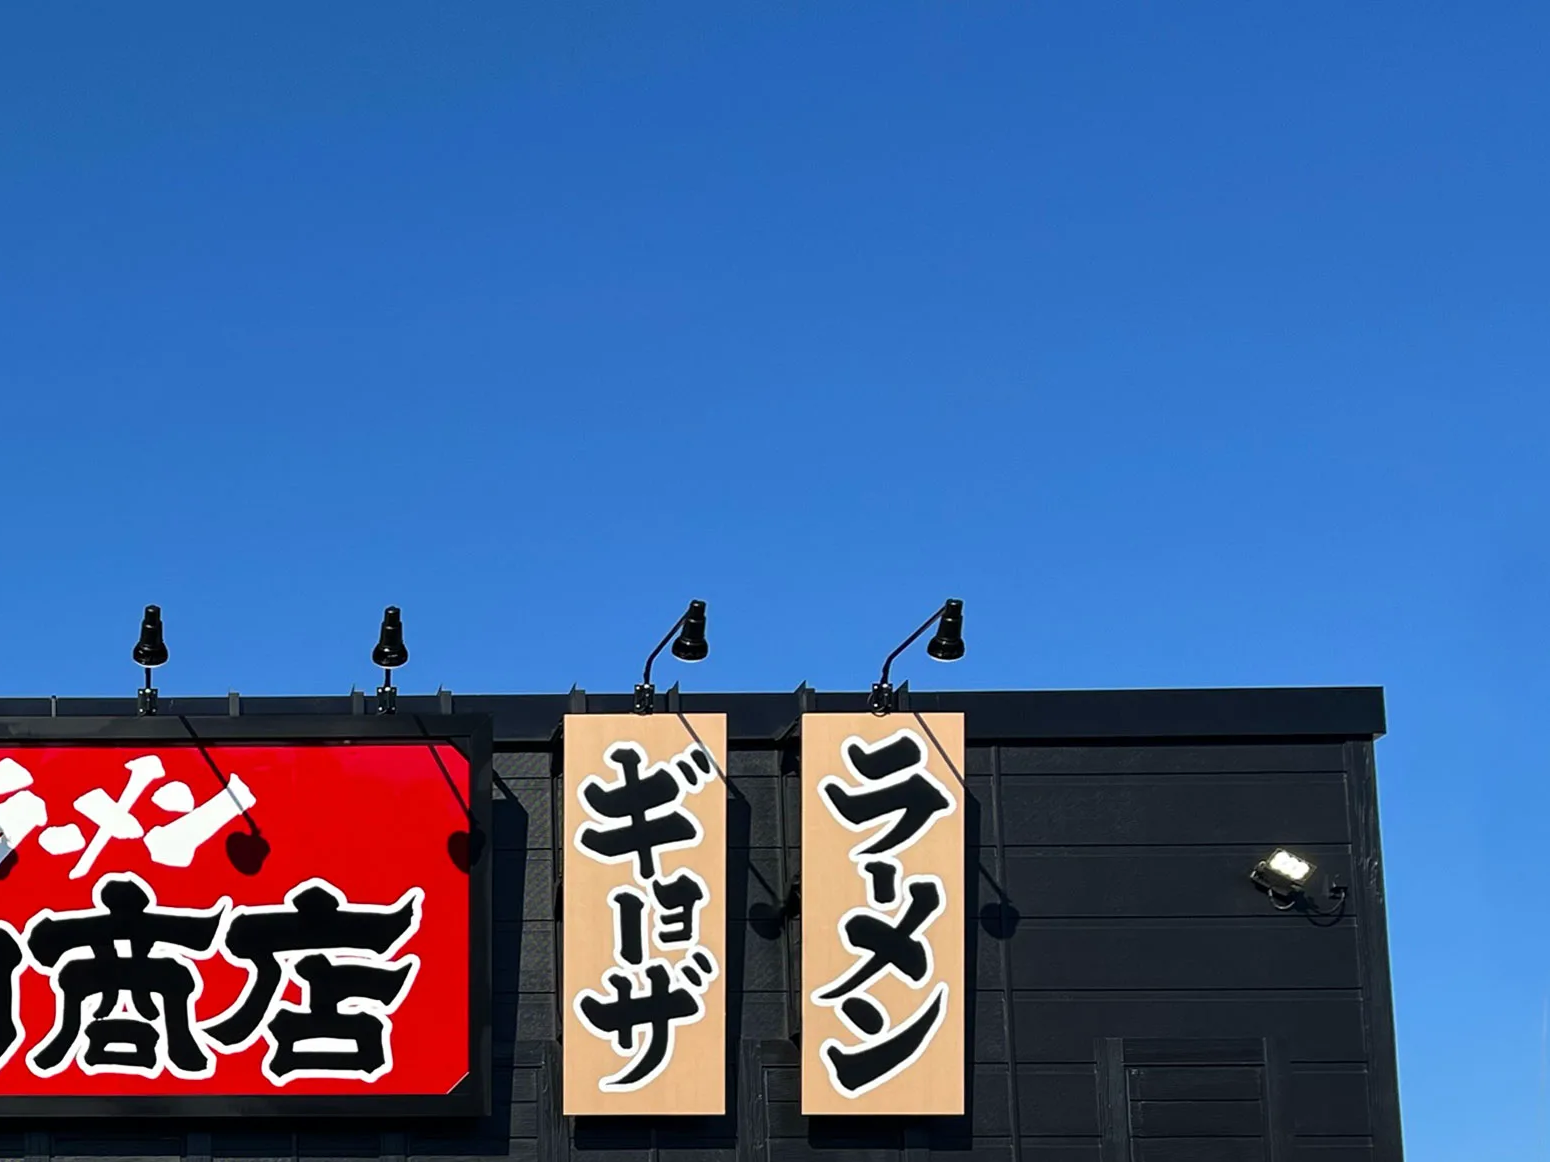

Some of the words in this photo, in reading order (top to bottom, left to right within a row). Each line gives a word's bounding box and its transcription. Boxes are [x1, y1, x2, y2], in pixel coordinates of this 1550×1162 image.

[574, 742, 718, 1092] ギョーザ
[811, 729, 956, 1098] ラーメン
